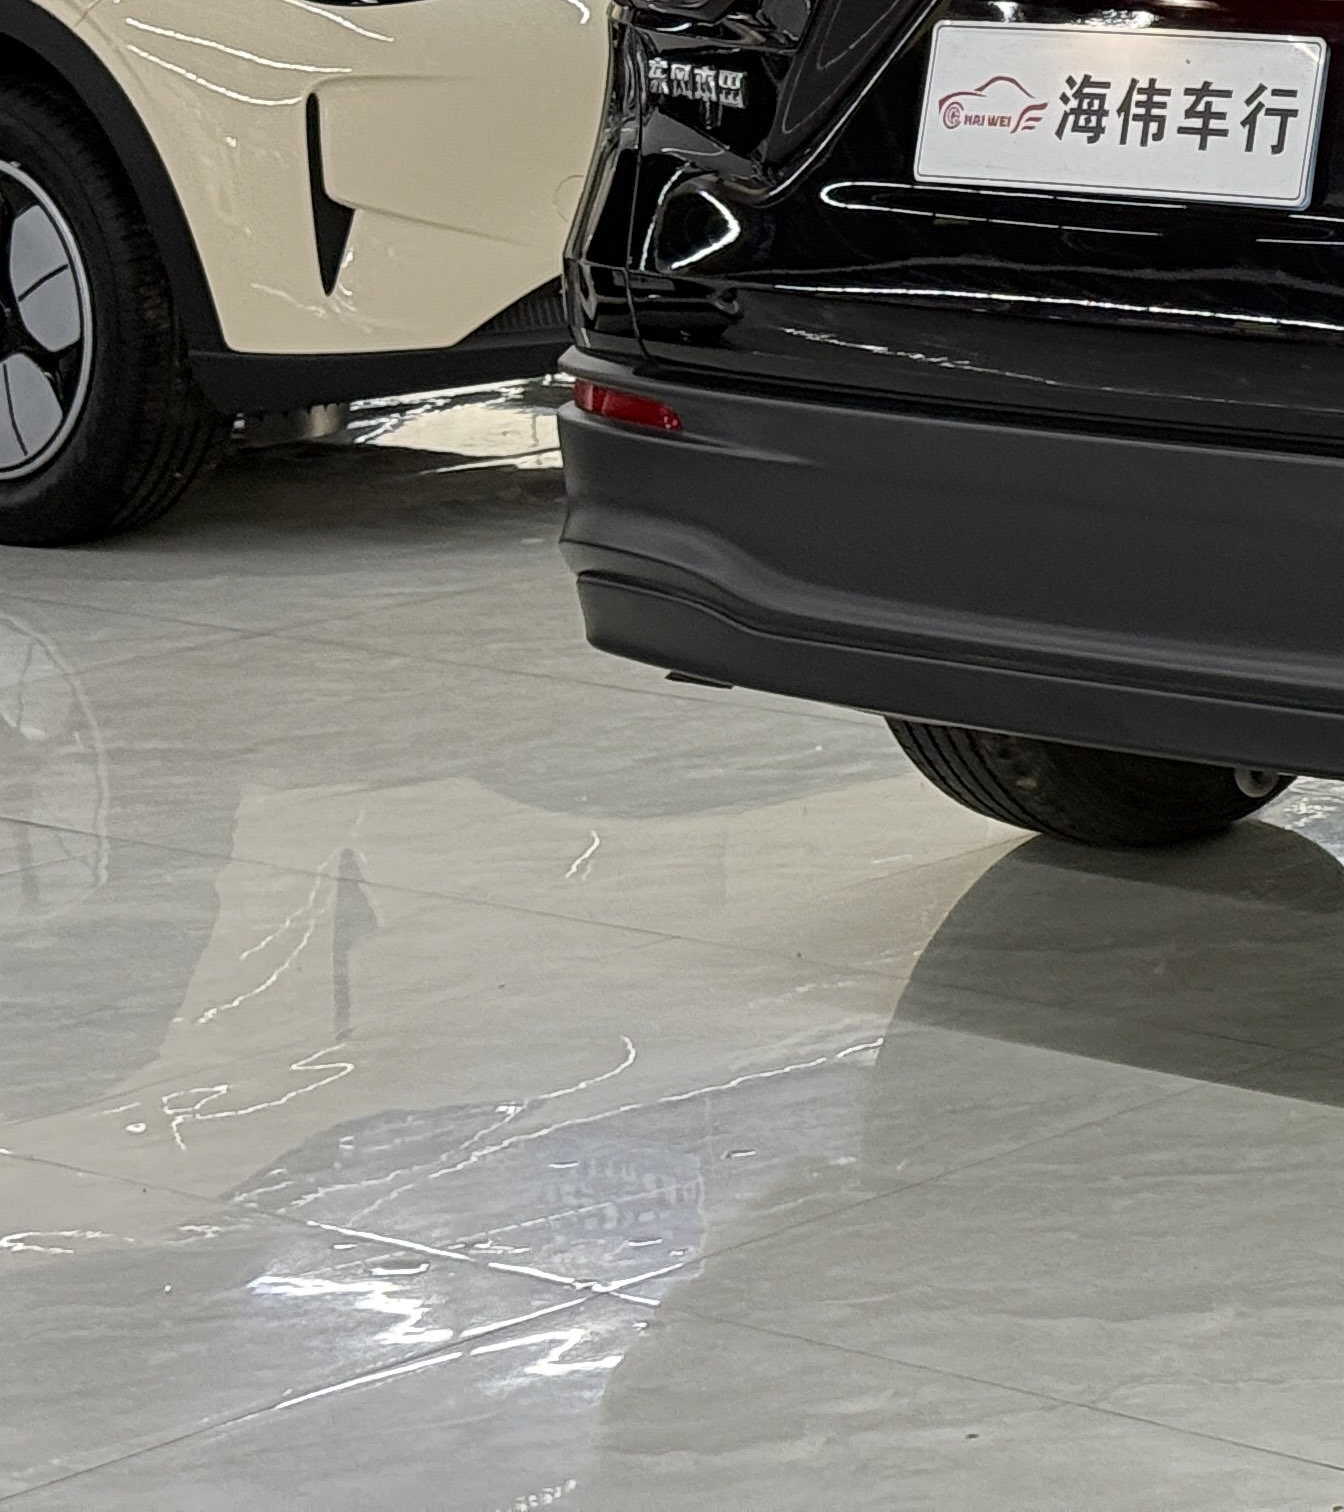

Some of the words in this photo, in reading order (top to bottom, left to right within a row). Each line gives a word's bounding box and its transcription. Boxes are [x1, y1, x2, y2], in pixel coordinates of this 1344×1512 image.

[648, 56, 745, 109] 东风本田
[988, 115, 1012, 127] WEI
[1054, 74, 1300, 156] 海伟车行
